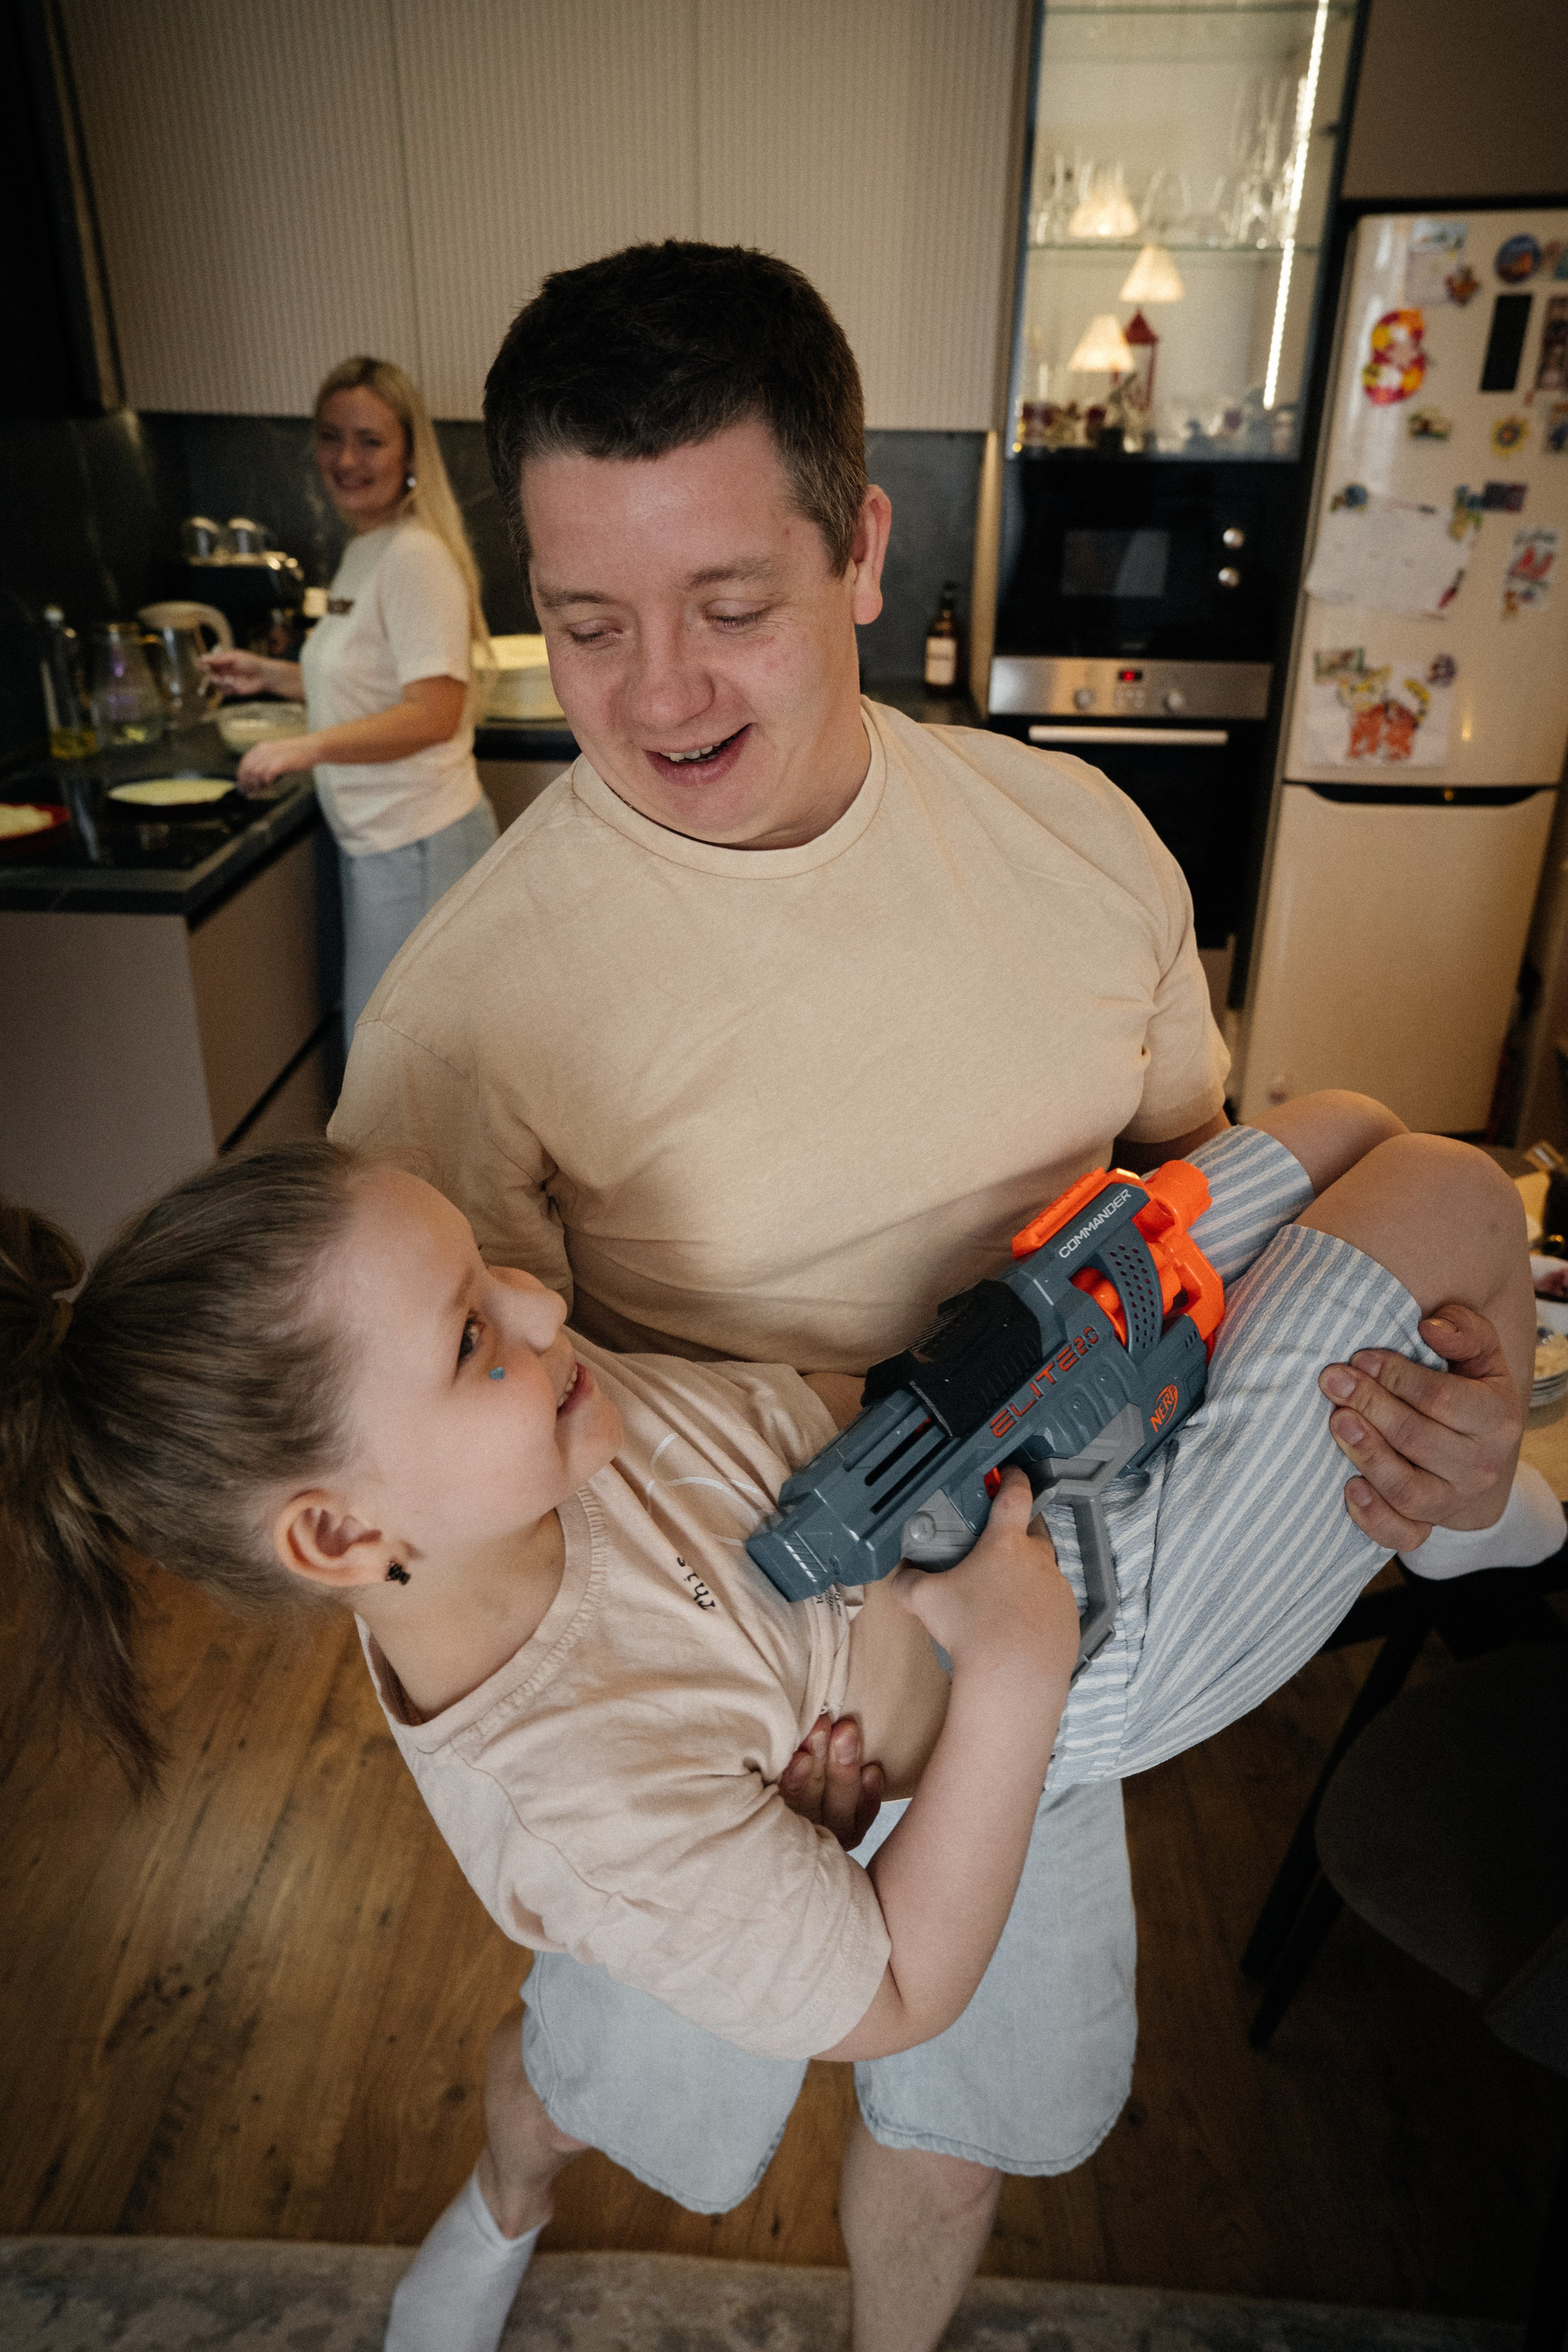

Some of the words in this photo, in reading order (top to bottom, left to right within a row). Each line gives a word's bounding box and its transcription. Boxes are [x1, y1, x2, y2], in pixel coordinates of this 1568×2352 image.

[1058, 1189, 1132, 1258] COMMANDER
[989, 1345, 1079, 1438] ELITE
[1150, 1383, 1177, 1433] NERF
